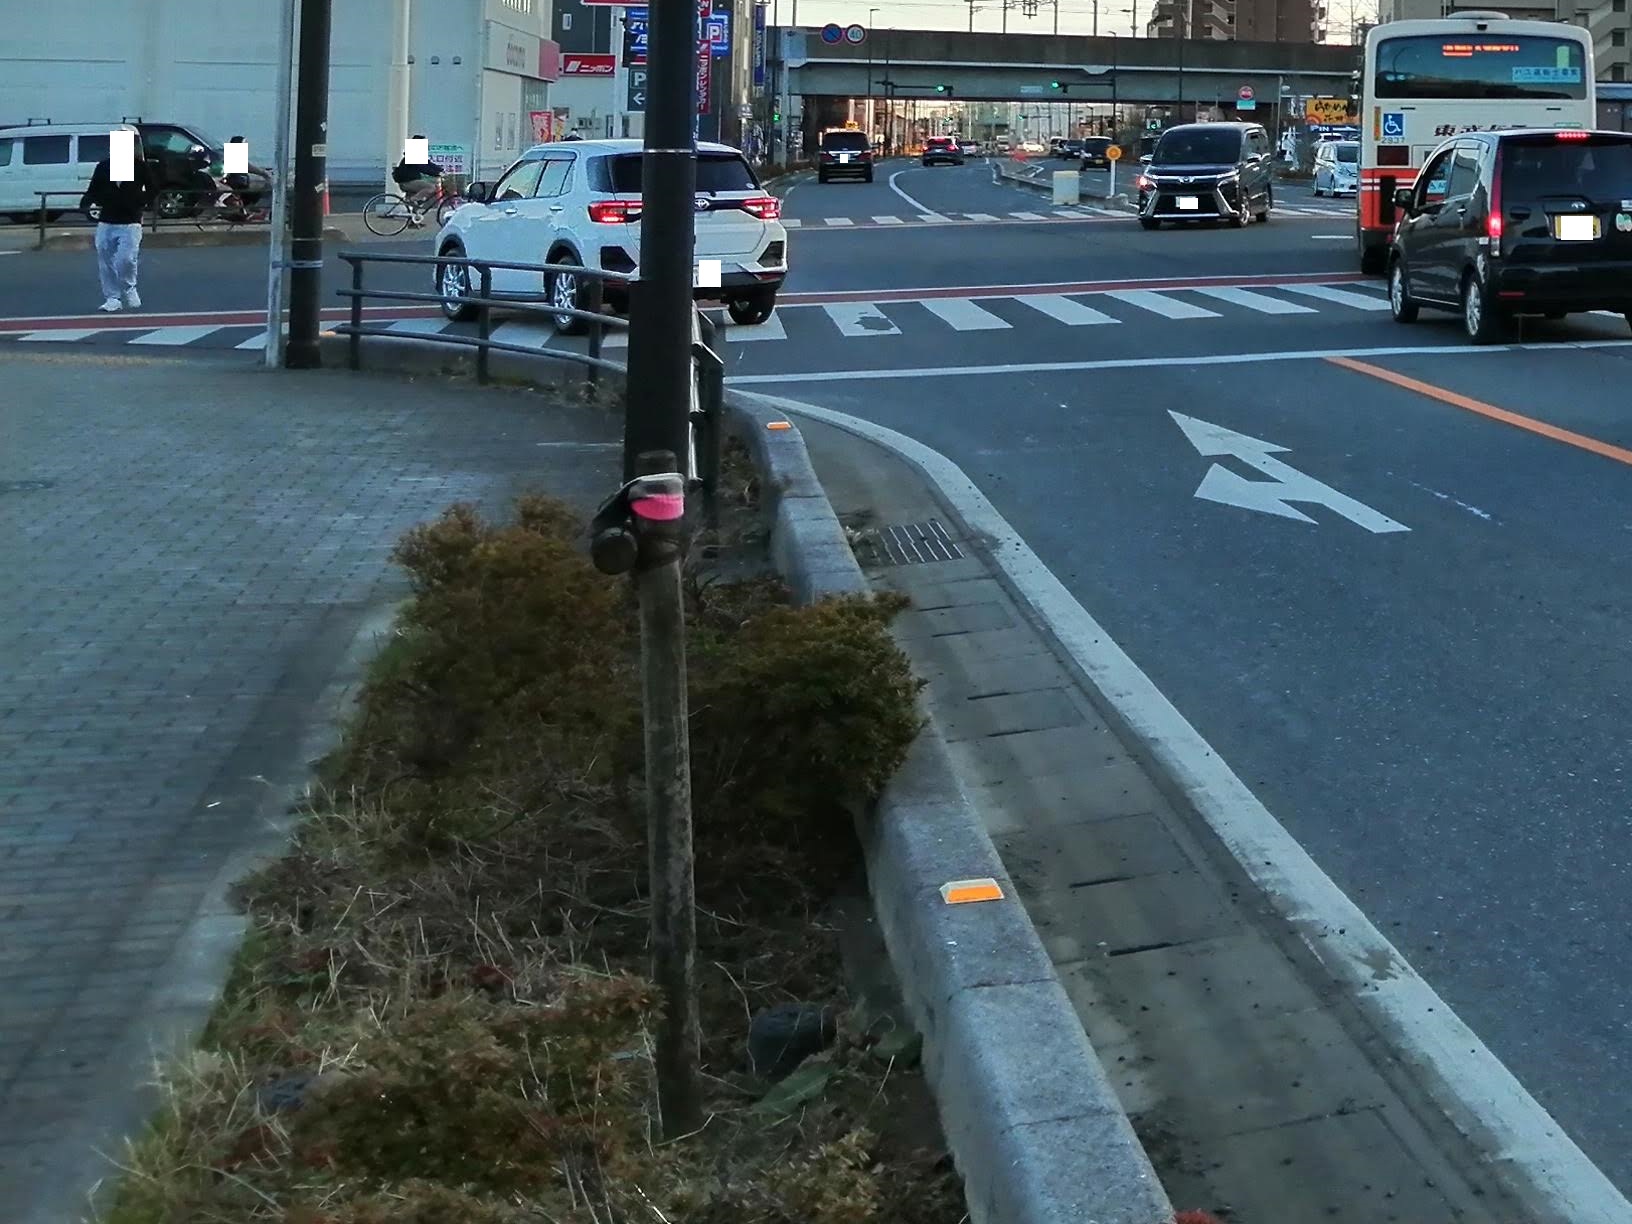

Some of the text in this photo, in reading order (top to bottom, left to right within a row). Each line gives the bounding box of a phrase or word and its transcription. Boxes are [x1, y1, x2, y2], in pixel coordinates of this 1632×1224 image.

[850, 29, 862, 39] 40
[578, 63, 613, 73] ニッポン
[1381, 136, 1406, 144] 2937
